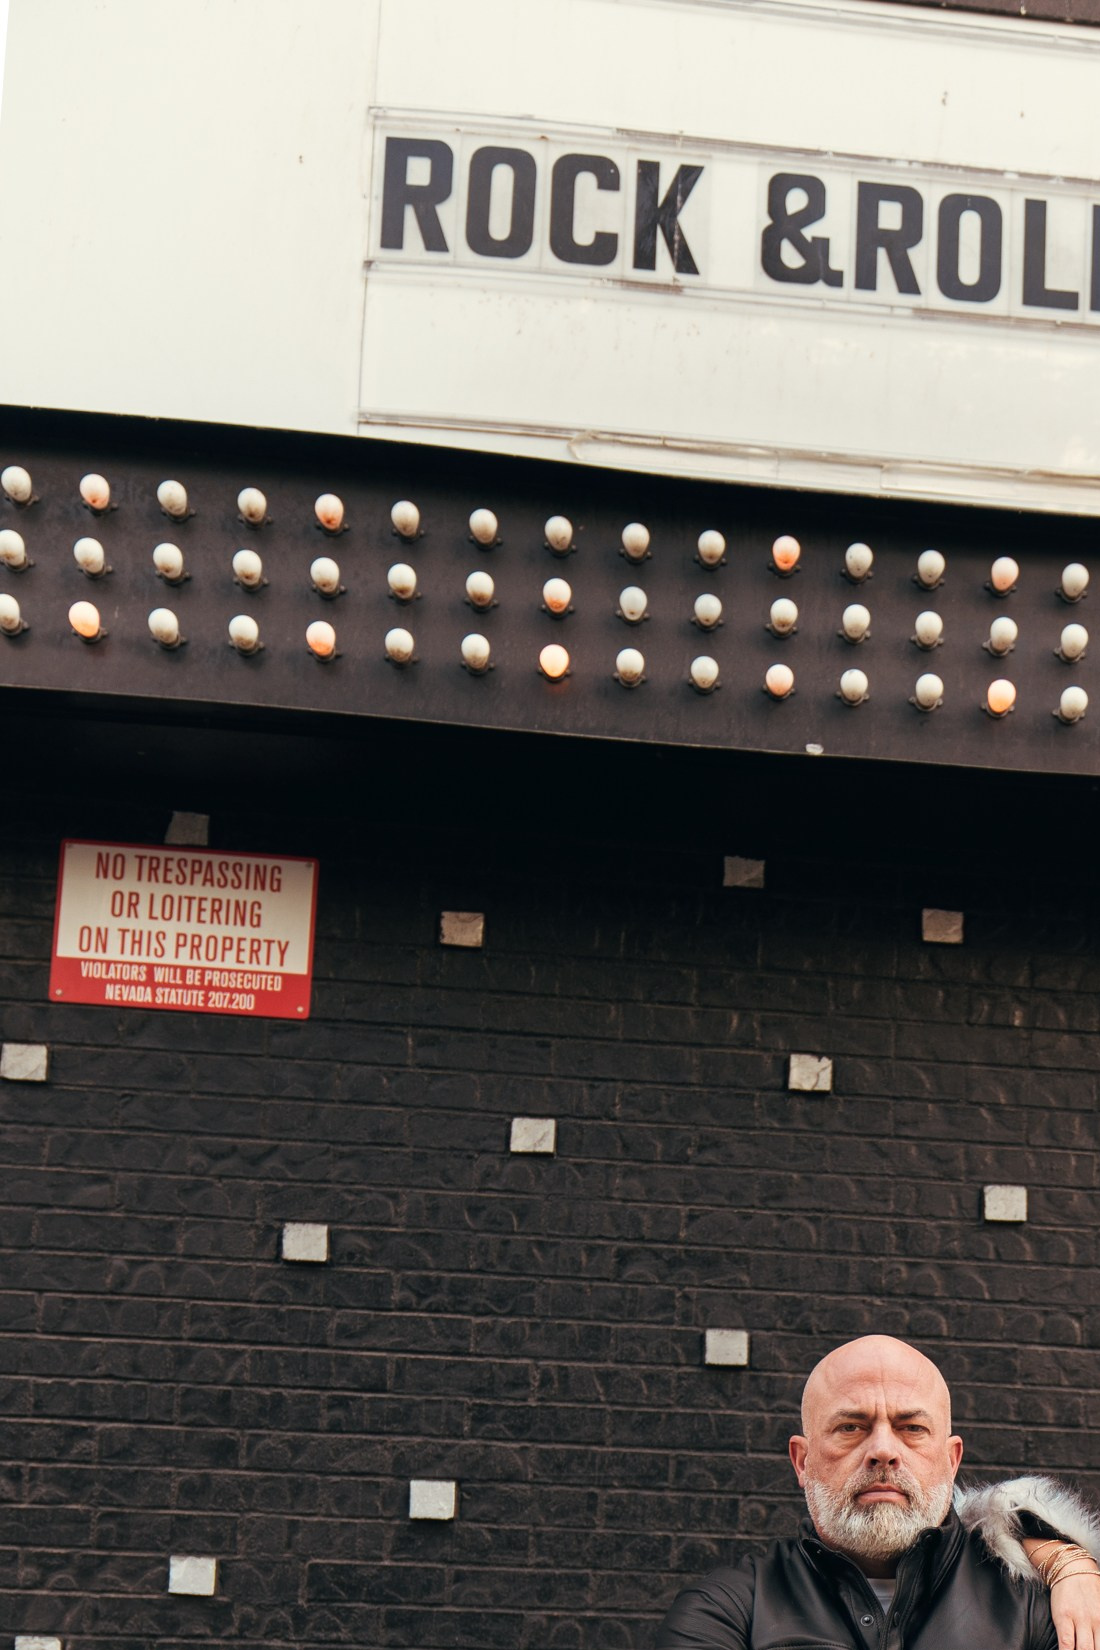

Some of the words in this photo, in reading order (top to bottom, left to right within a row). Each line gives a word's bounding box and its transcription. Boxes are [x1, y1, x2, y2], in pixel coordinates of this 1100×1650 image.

[380, 136, 705, 277] ROCK
[95, 851, 125, 880] NO
[134, 854, 282, 893] TRESPASSING
[110, 890, 140, 918] OR
[148, 893, 262, 928] LOITERING
[78, 925, 109, 954] ON
[116, 928, 166, 958] THIS
[174, 932, 290, 967] PROPERTY
[80, 960, 147, 983] VIOLATORS
[153, 966, 183, 986] WILL
[185, 969, 201, 987] BE
[204, 972, 283, 992] PROSECUTED
[105, 984, 152, 1004] NEVADA
[155, 987, 205, 1008] STATUTE
[207, 991, 255, 1010] 207.200
